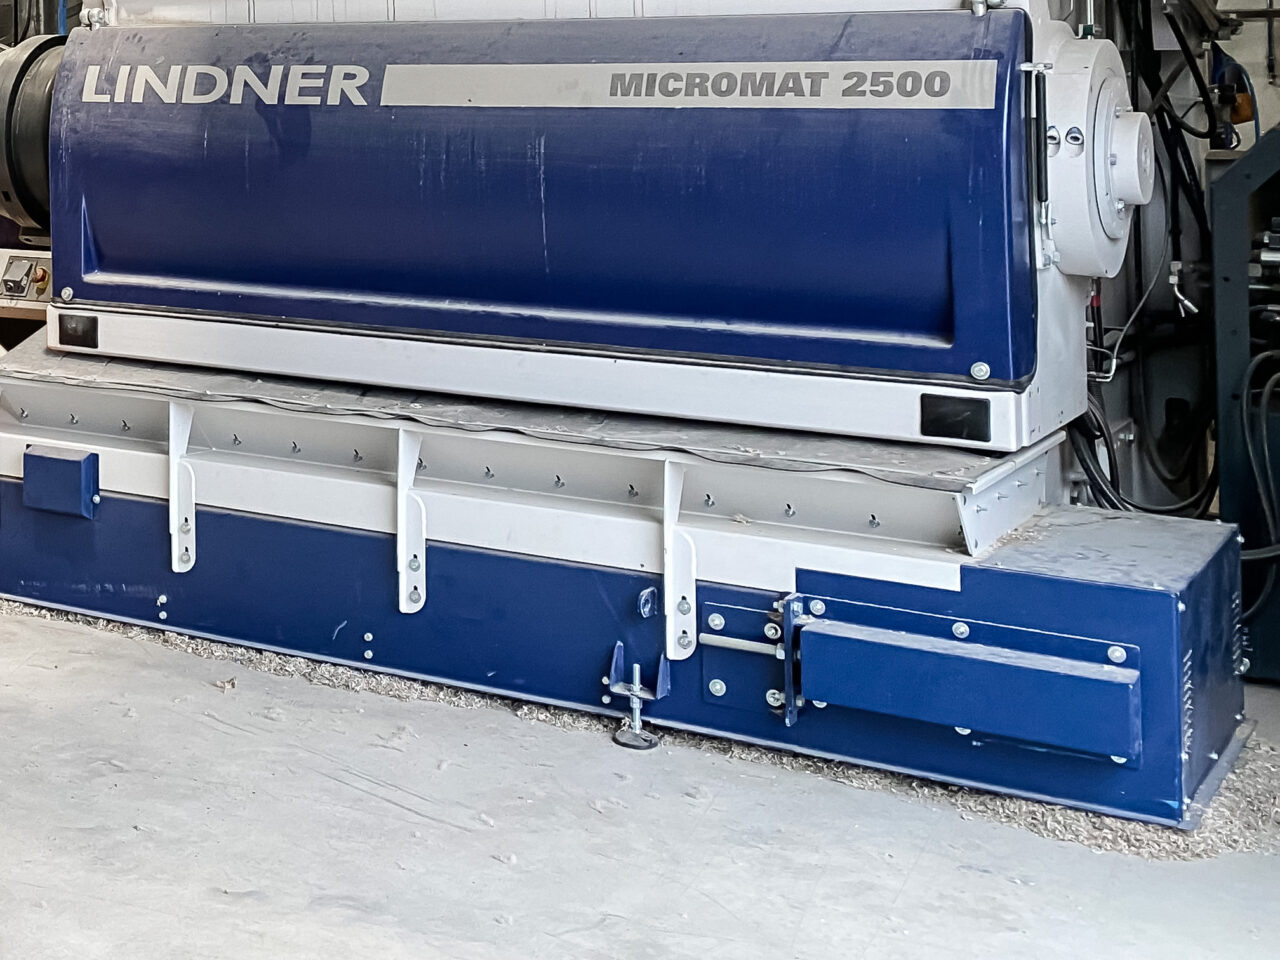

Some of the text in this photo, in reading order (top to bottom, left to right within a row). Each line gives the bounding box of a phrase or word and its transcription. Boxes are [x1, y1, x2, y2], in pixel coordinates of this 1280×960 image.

[81, 64, 951, 107] LINDNER MICROMAT 2500
